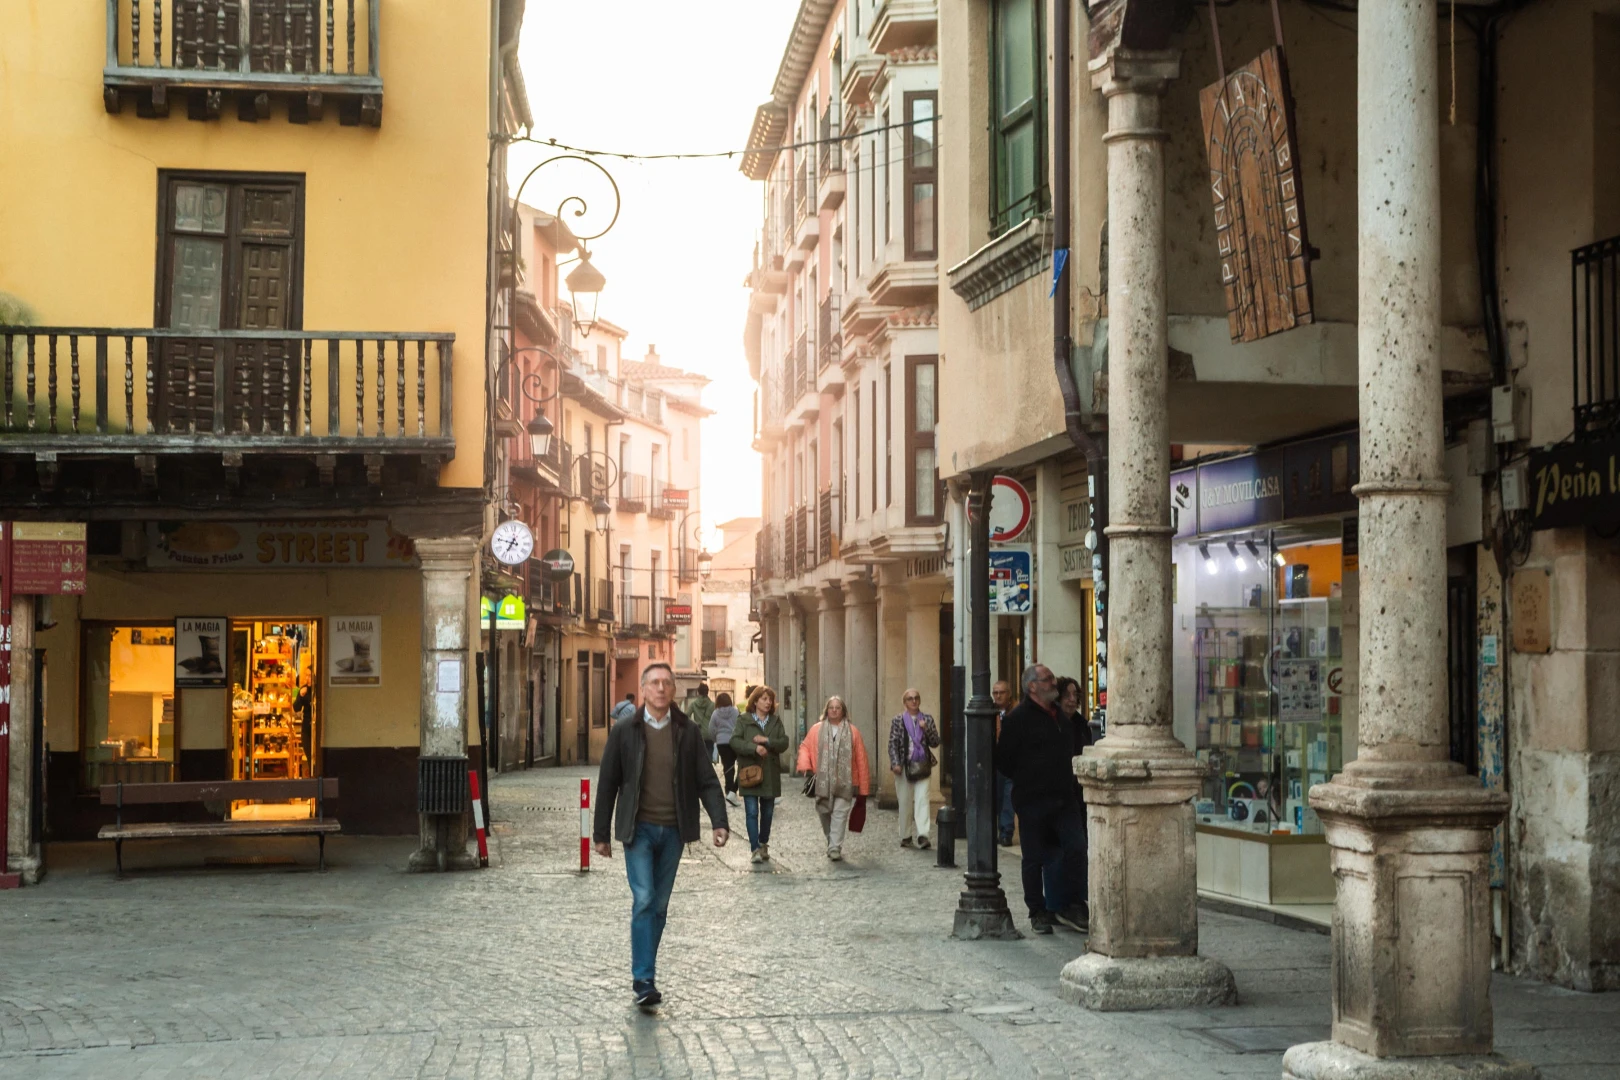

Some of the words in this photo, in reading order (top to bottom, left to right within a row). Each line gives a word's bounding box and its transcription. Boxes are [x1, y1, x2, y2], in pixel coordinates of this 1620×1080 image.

[1536, 463, 1601, 518] Peña
[1609, 454, 1620, 494] l
[1067, 501, 1090, 532] TEOD
[168, 550, 209, 565] Patatas
[212, 552, 244, 564] Fritas
[256, 532, 370, 564] STREET
[182, 621, 193, 632] LA
[194, 621, 220, 632] MAGIA
[336, 621, 347, 632] LA
[348, 621, 374, 632] MAGIA
